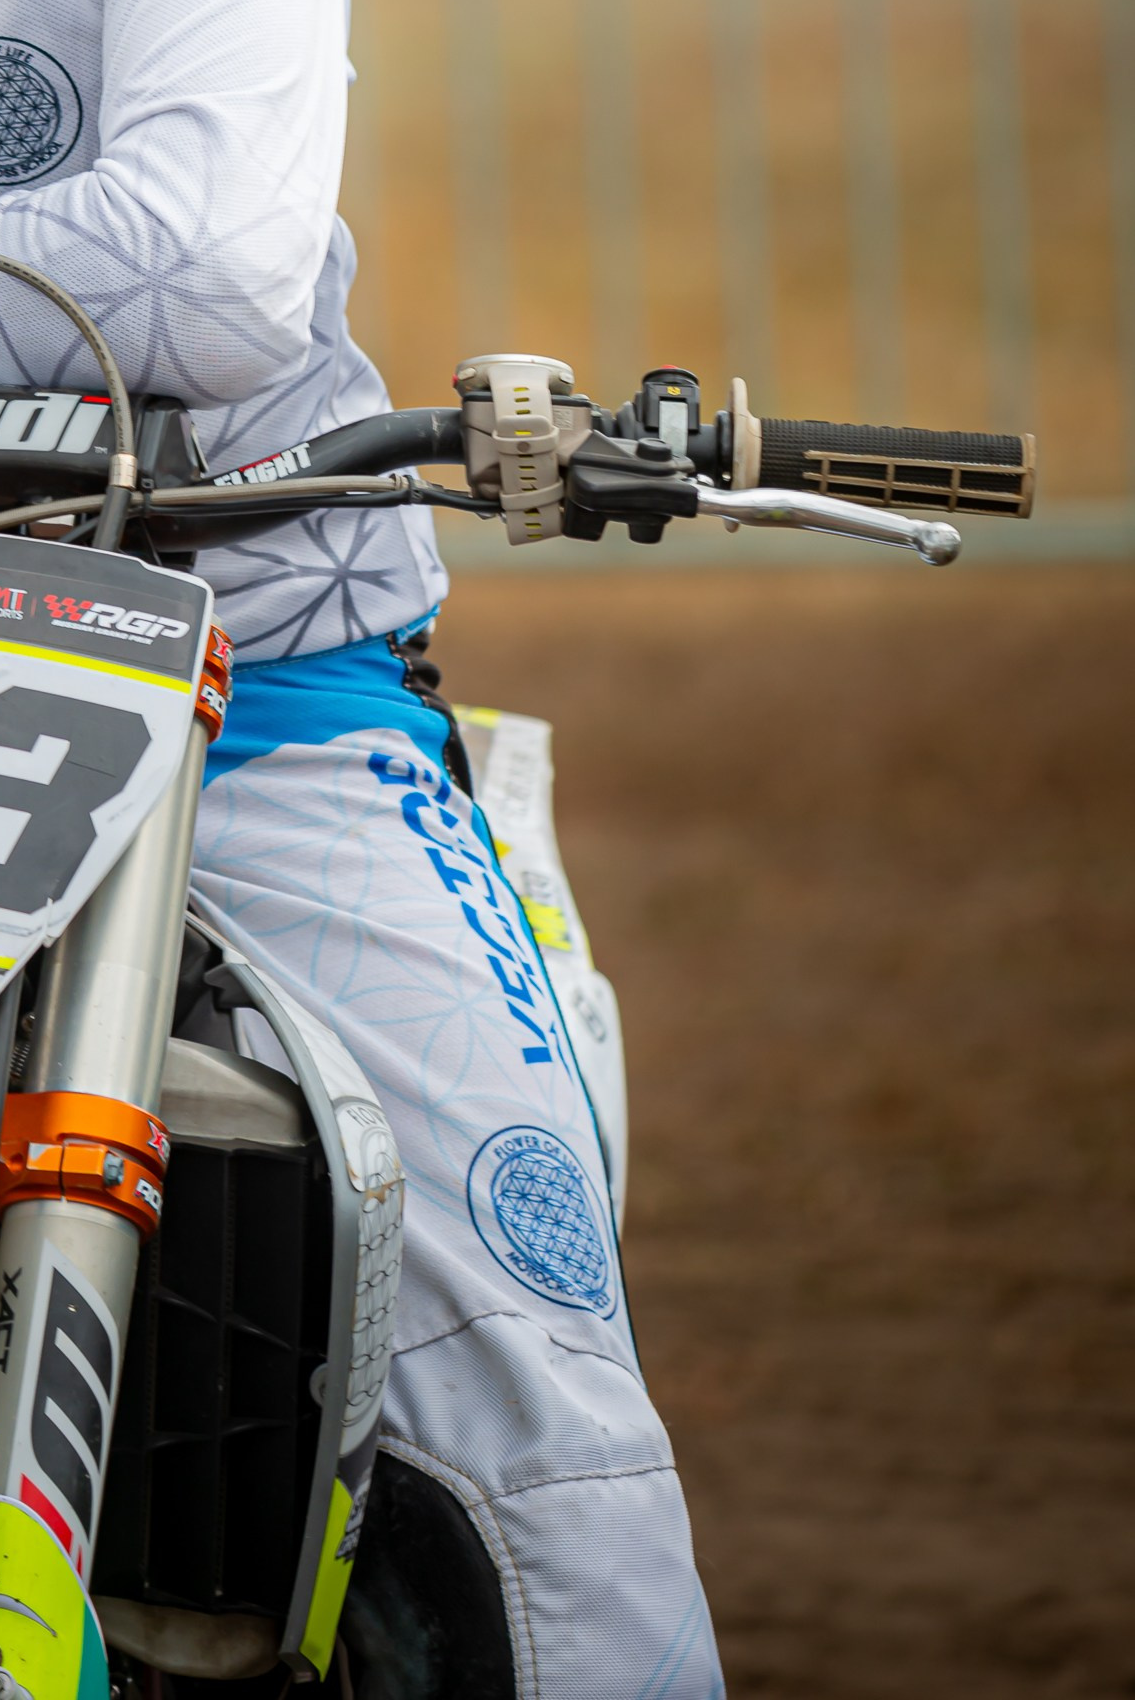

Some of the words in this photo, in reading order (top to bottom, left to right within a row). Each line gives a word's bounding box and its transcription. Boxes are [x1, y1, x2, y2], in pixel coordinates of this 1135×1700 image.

[5, 47, 35, 64] LIFE
[78, 602, 191, 639] RGP
[493, 1135, 541, 1161] FLOWER
